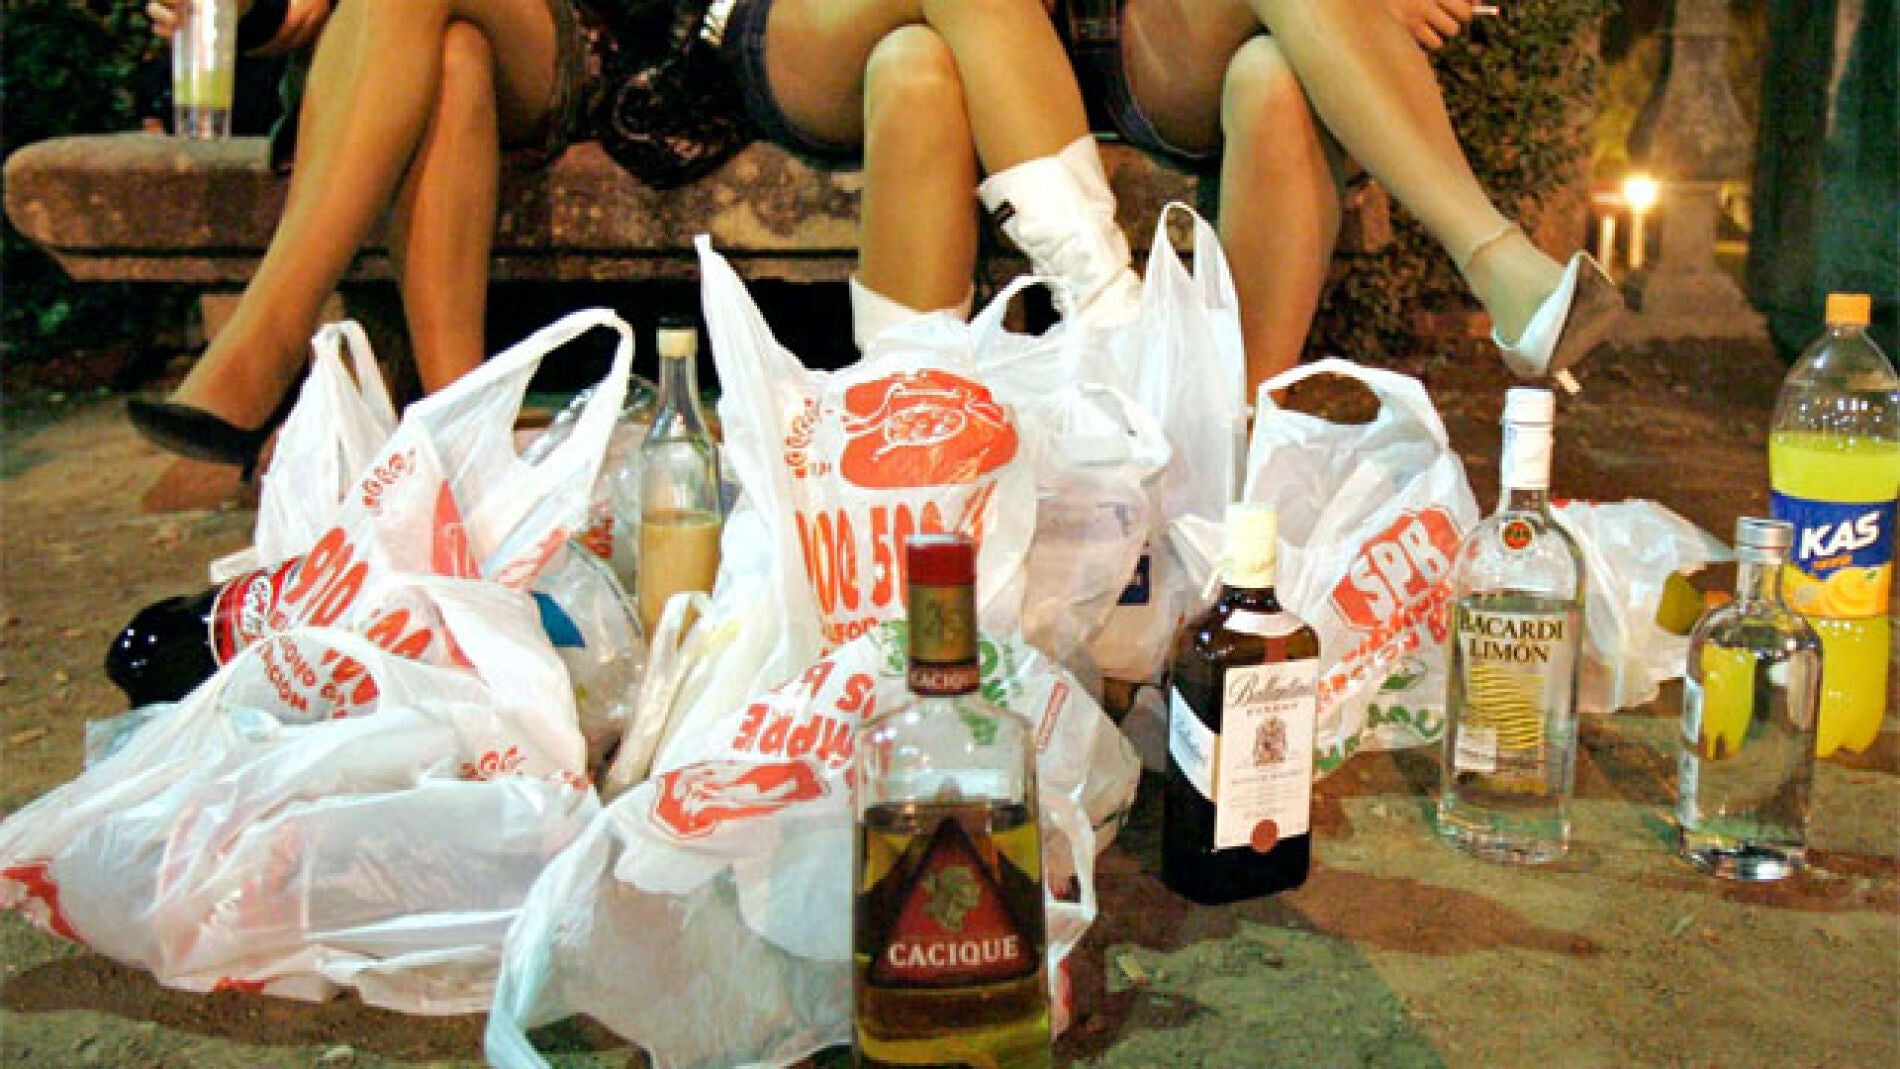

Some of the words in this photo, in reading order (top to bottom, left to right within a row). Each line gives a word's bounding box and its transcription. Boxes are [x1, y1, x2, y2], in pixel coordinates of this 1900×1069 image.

[1799, 510, 1881, 559] KAS
[1350, 518, 1450, 628] SPB
[1459, 608, 1563, 639] BACARDI
[888, 935, 1020, 968] CACIQUE
